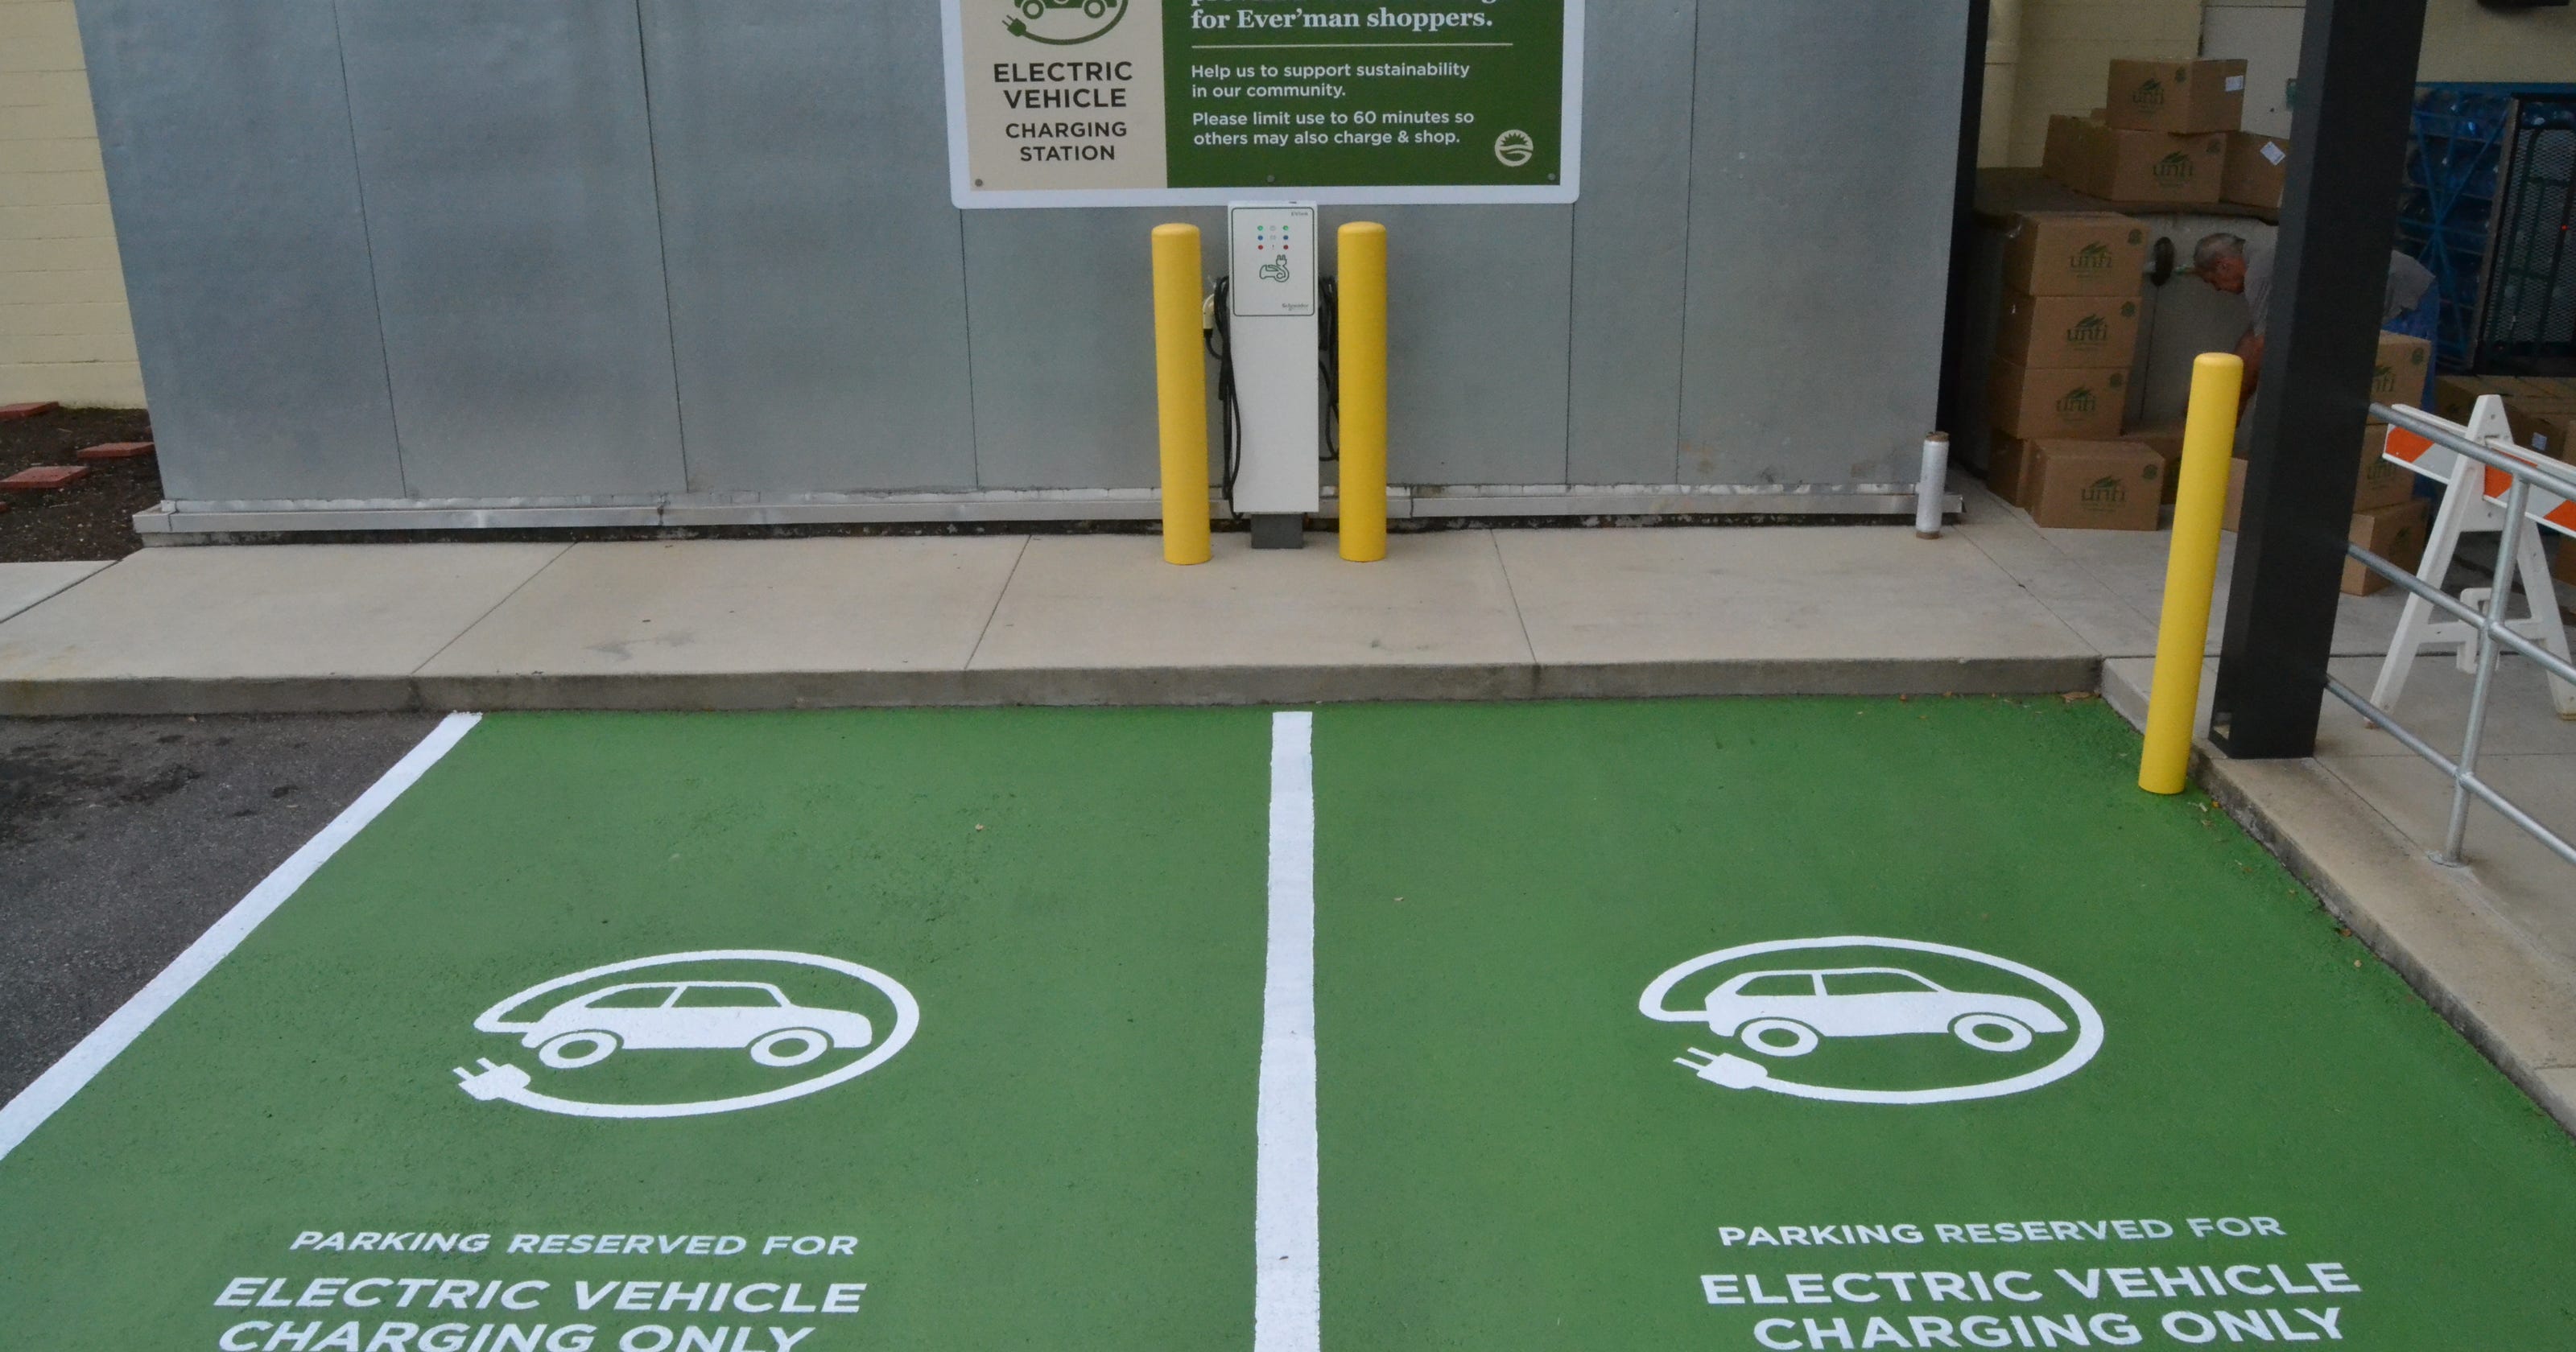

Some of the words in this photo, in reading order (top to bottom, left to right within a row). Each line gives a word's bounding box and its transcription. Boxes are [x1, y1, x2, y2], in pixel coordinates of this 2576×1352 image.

[1191, 8, 1231, 29] for
[1366, 6, 1492, 31] shoppers.
[993, 61, 1133, 83] ELECTRIC
[1191, 64, 1231, 80] Help
[1236, 67, 1255, 78] us
[1261, 64, 1279, 78] to
[1283, 64, 1352, 80] support
[1356, 62, 1470, 78] sustainability
[1003, 88, 1127, 109] VEHICLE
[1192, 84, 1208, 97] in
[1212, 86, 1241, 97] our
[1246, 82, 1346, 99] community.
[1192, 112, 1248, 126] Please
[1253, 111, 1290, 125] limit
[1296, 113, 1325, 125] use
[1330, 111, 1348, 125] to
[1353, 110, 1377, 124] 60
[1382, 110, 1450, 124] minutes
[1455, 113, 1475, 124] so
[1005, 121, 1127, 138] CHARGING
[1193, 131, 1249, 146] others
[1253, 134, 1289, 147] may
[1294, 130, 1328, 144] also
[1333, 130, 1393, 146] charge
[1397, 130, 1410, 143] &
[1414, 129, 1460, 146] shop.
[1020, 145, 1115, 162] STATION
[1718, 1223, 1925, 1246] PARKING
[1934, 1218, 2174, 1243] RESERVED
[2190, 1216, 2286, 1238] FOR
[289, 1230, 491, 1253] PARKING
[506, 1234, 747, 1255] RESERVED
[762, 1235, 858, 1255] FOR
[1699, 1270, 2043, 1305] ELECTRIC
[2054, 1262, 2361, 1299] VEHICLE
[213, 1277, 551, 1310] ELECTRIC
[575, 1280, 868, 1313] VEHICLE
[219, 1320, 597, 1352] CHARGING
[619, 1324, 816, 1352] ONLY
[1753, 1313, 2143, 1350] CHARGING
[2161, 1307, 2343, 1343] ONLY
